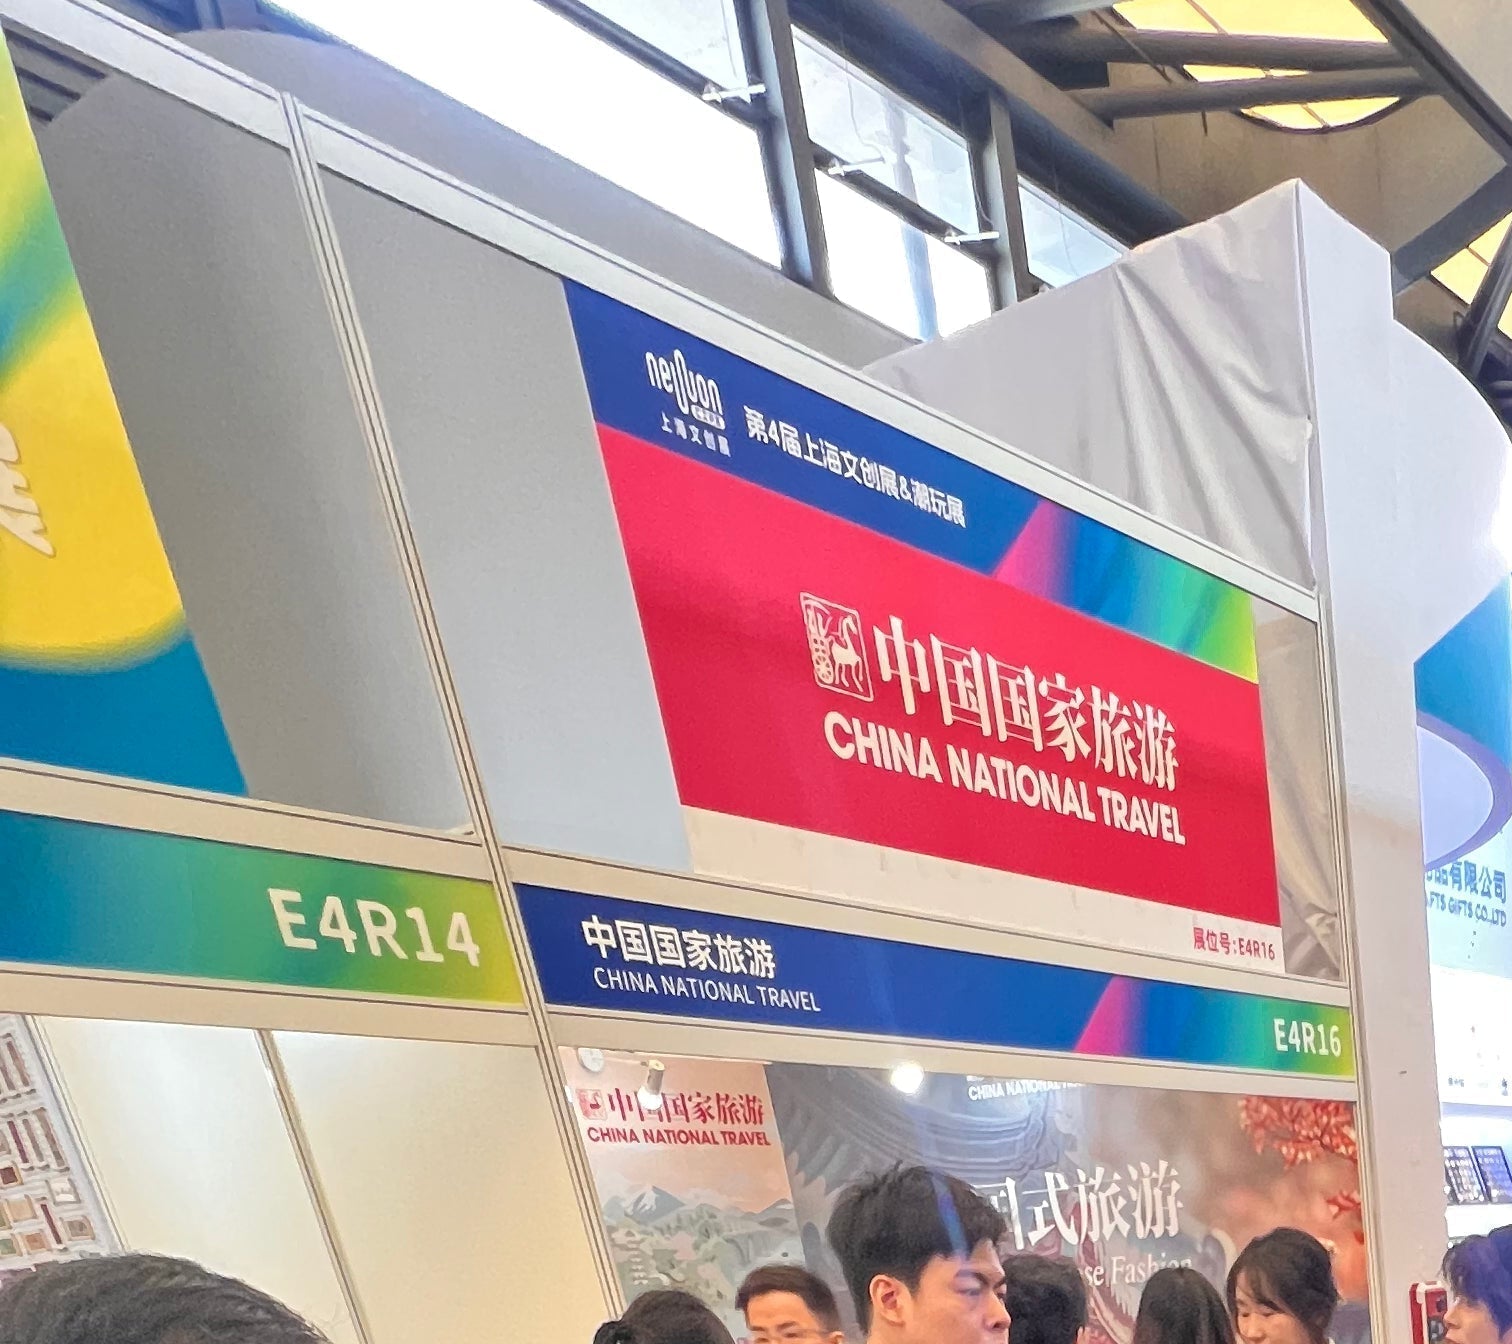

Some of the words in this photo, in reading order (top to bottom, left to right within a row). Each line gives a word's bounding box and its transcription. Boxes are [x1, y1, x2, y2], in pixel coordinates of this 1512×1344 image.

[743, 405, 966, 528] 第4届上海文创展&潮玩展
[872, 614, 1180, 792] 中国国家旅游
[823, 710, 943, 785] CHINA
[947, 747, 1095, 823] NATIONAL
[1096, 782, 1187, 846] TRAVEL
[267, 887, 481, 967] E4R14
[581, 913, 777, 981] 中国国家旅游
[593, 966, 658, 997] CHINA
[660, 974, 754, 1006] NATIONAL
[756, 984, 821, 1013] TRAVEL
[1273, 1017, 1342, 1058] E4R16
[968, 1083, 1005, 1101] CHINA
[587, 1127, 640, 1144] CHINA
[642, 1128, 720, 1146] NATIONAL
[720, 1130, 772, 1147] TRAVEL
[1111, 1252, 1193, 1284] Fash
